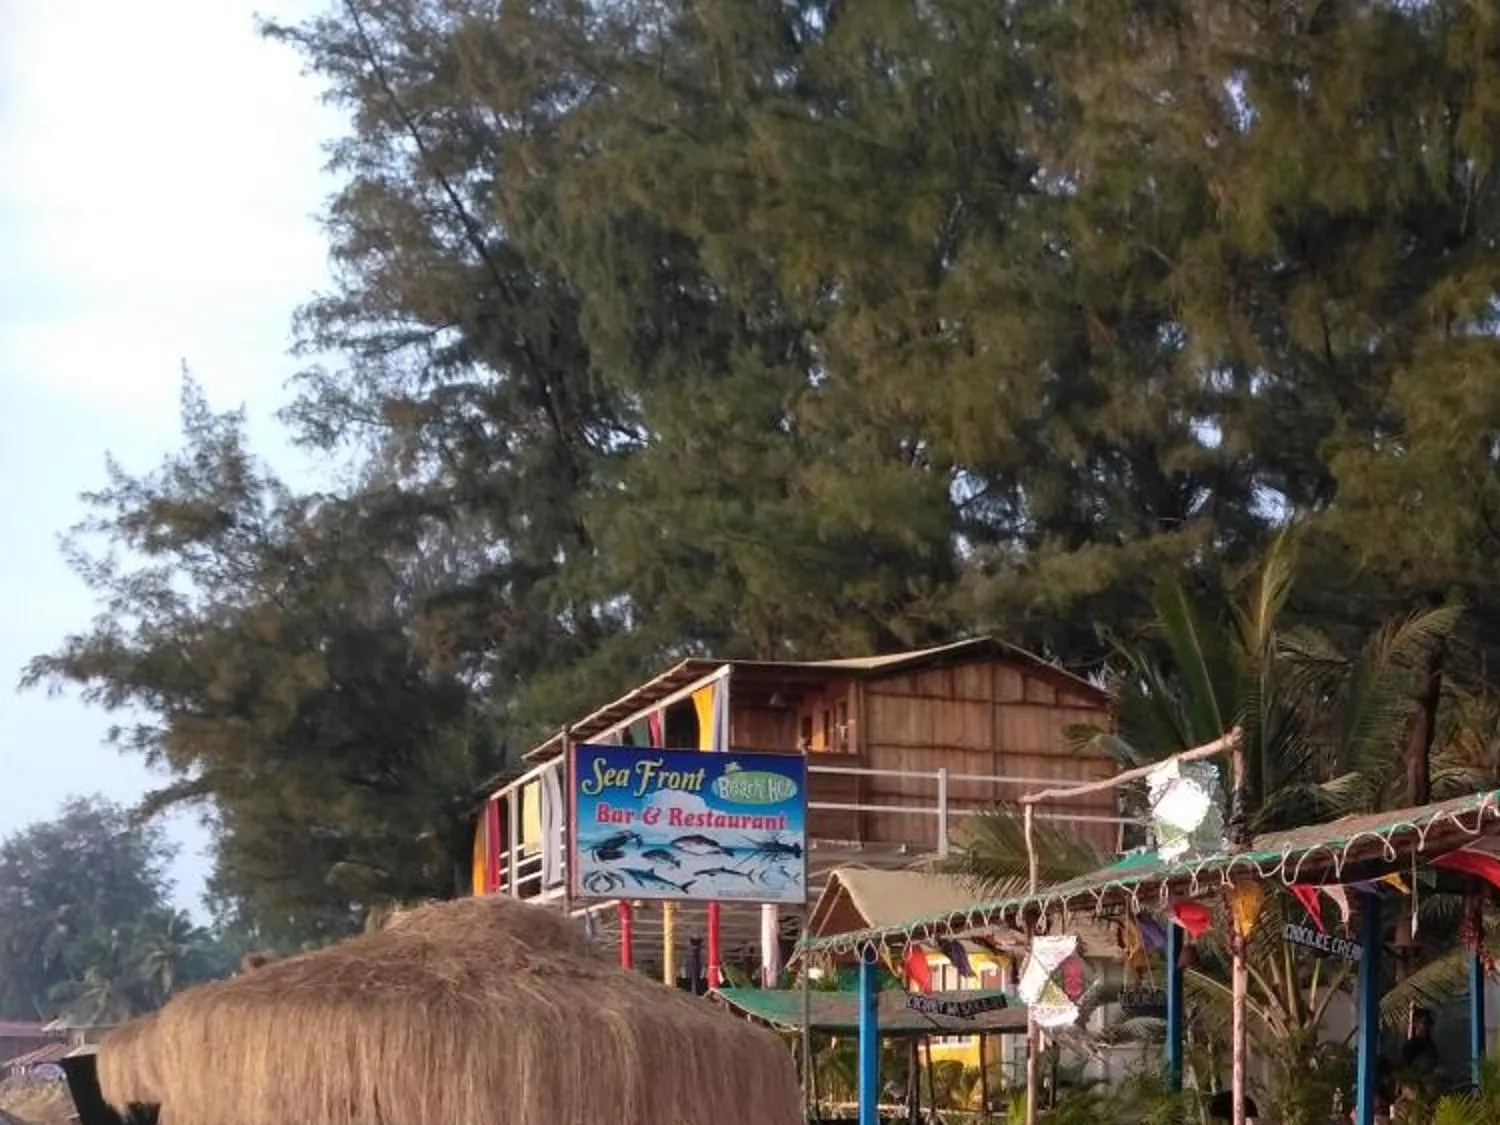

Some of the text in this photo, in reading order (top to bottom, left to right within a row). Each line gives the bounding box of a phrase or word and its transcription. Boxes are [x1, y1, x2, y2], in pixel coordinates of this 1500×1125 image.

[582, 757, 706, 798] Sea Front
[596, 802, 786, 830] Bar & Restaurant
